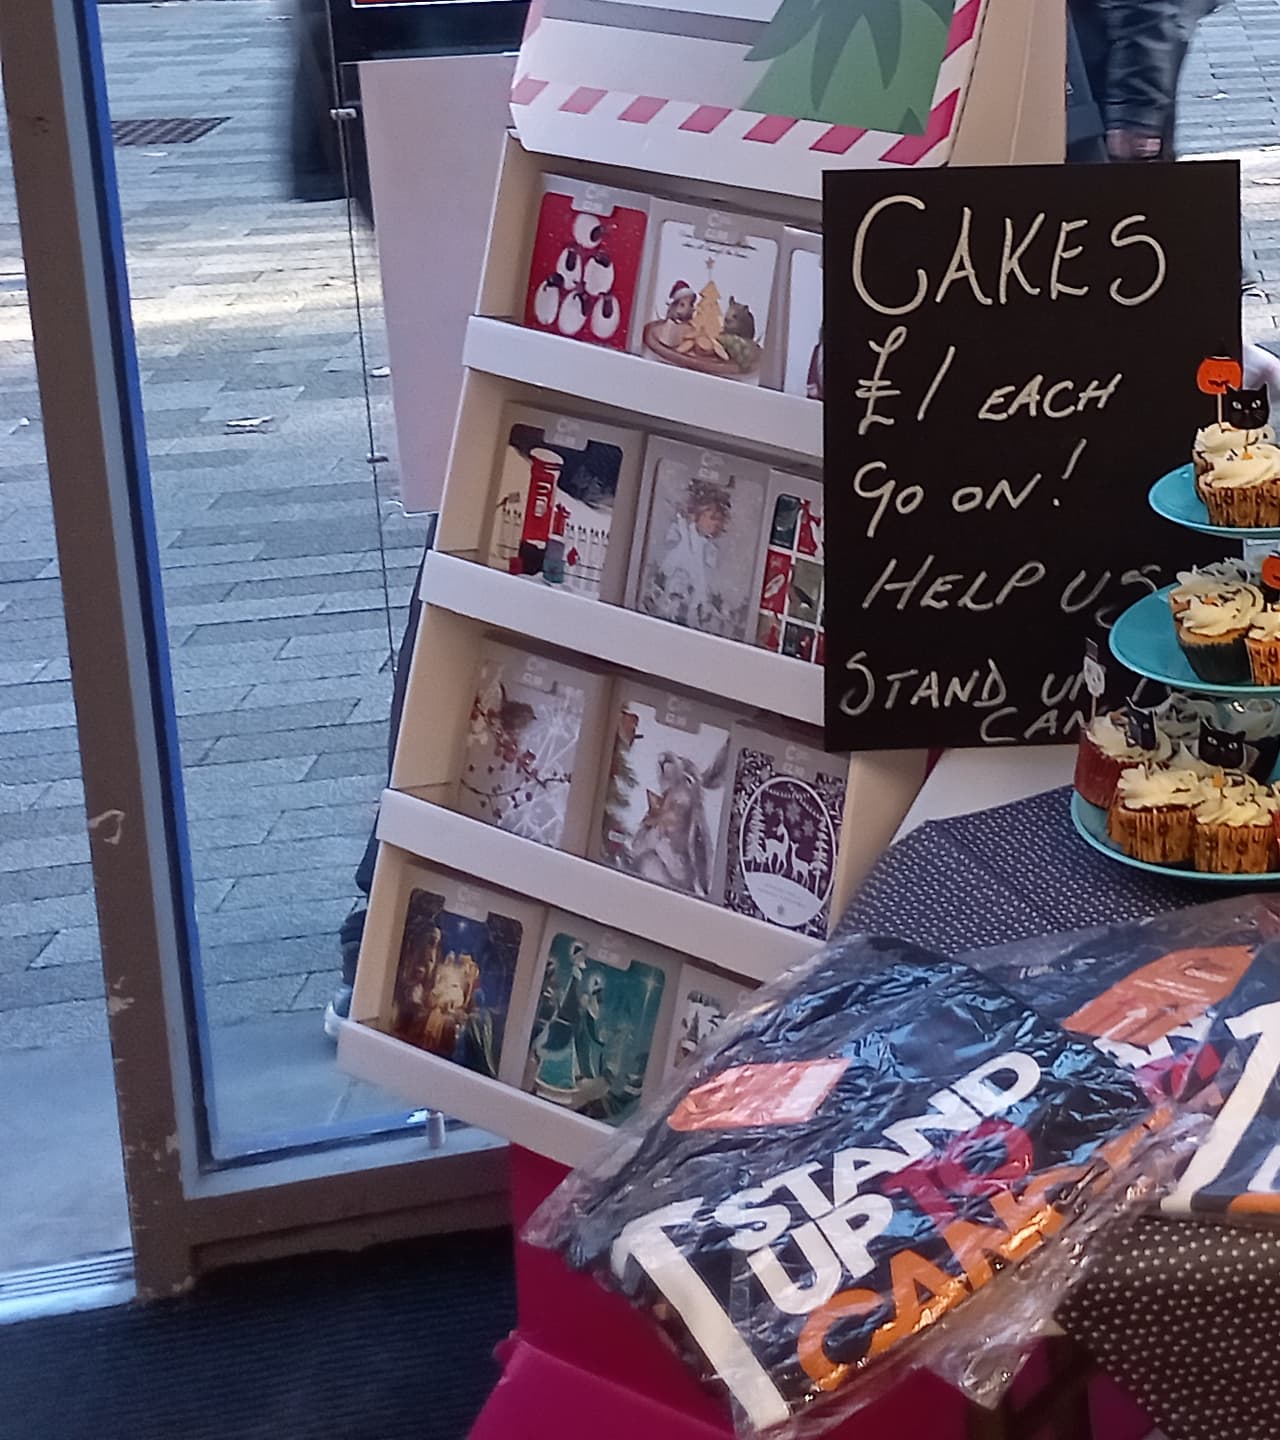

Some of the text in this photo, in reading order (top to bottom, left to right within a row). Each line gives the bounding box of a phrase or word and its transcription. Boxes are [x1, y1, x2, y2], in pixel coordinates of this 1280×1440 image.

[854, 326, 1123, 435] £1 EACH
[862, 553, 1046, 613] HELP
[839, 651, 1007, 716] STAND
[979, 706, 1093, 743] CAN
[716, 1050, 1042, 1253] STAND
[745, 1118, 1034, 1317] UP TO
